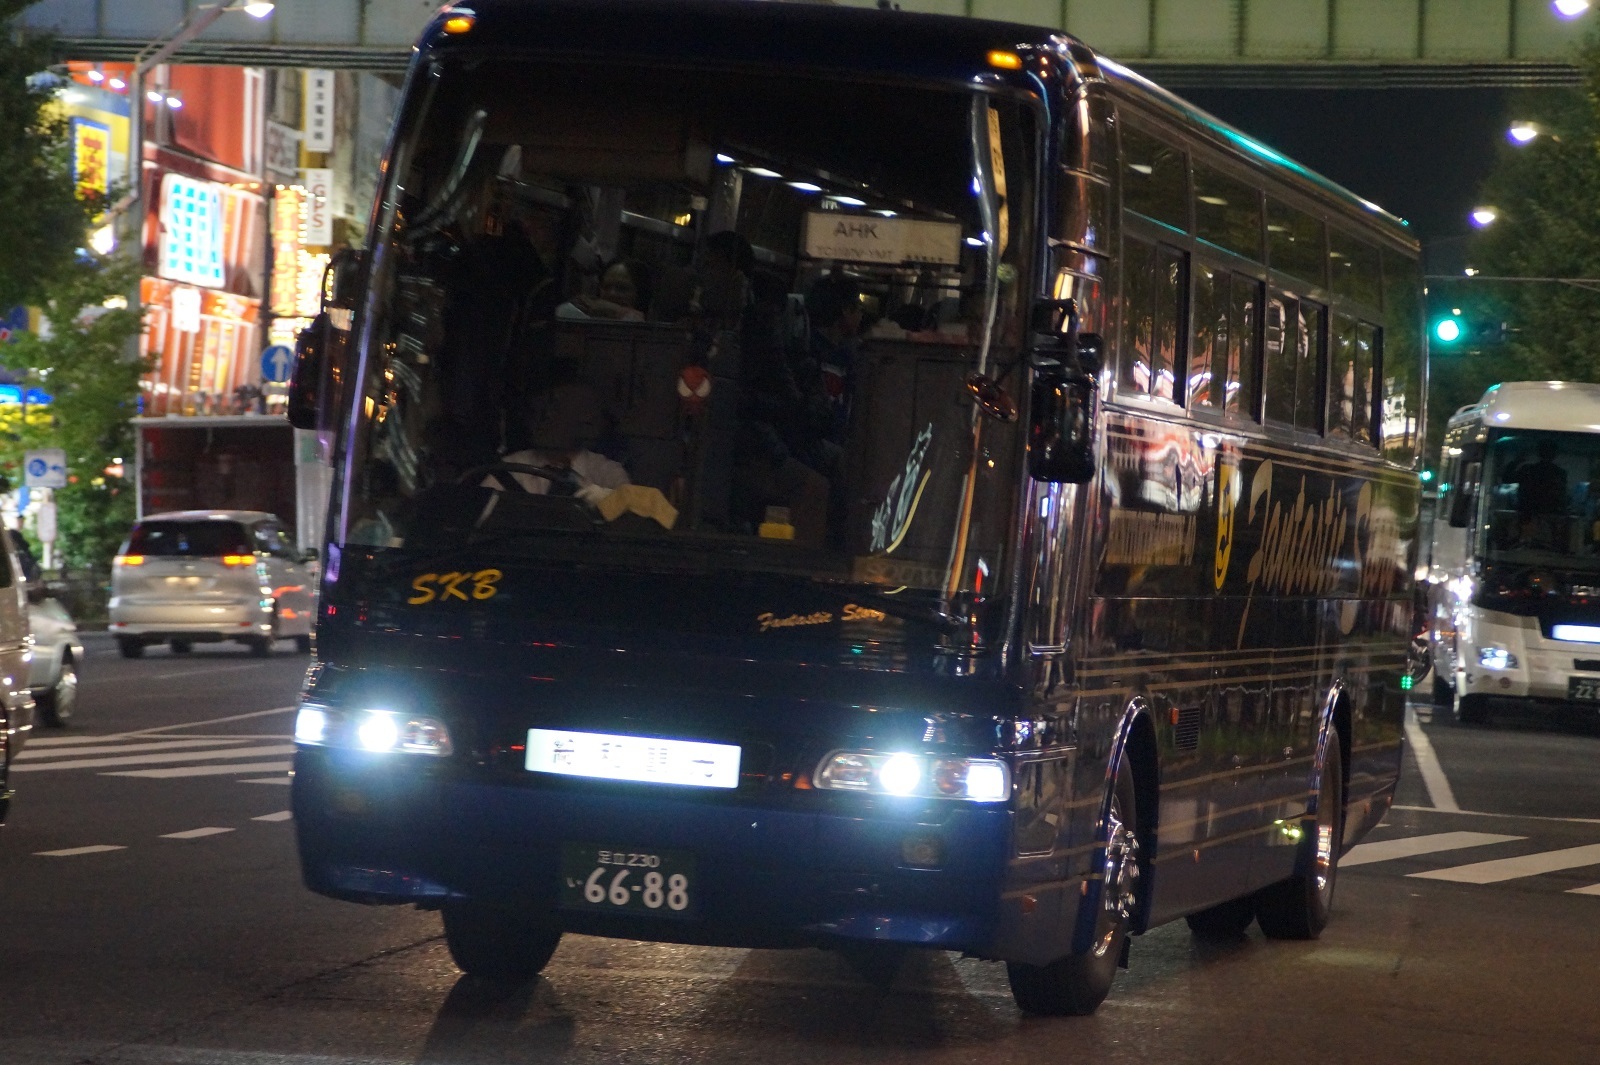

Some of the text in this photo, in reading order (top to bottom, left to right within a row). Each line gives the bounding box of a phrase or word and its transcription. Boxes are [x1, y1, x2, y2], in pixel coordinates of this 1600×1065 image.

[312, 183, 327, 228] GPS
[833, 221, 879, 240] AHK
[407, 568, 504, 606] SKB
[584, 866, 690, 912] 66-88
